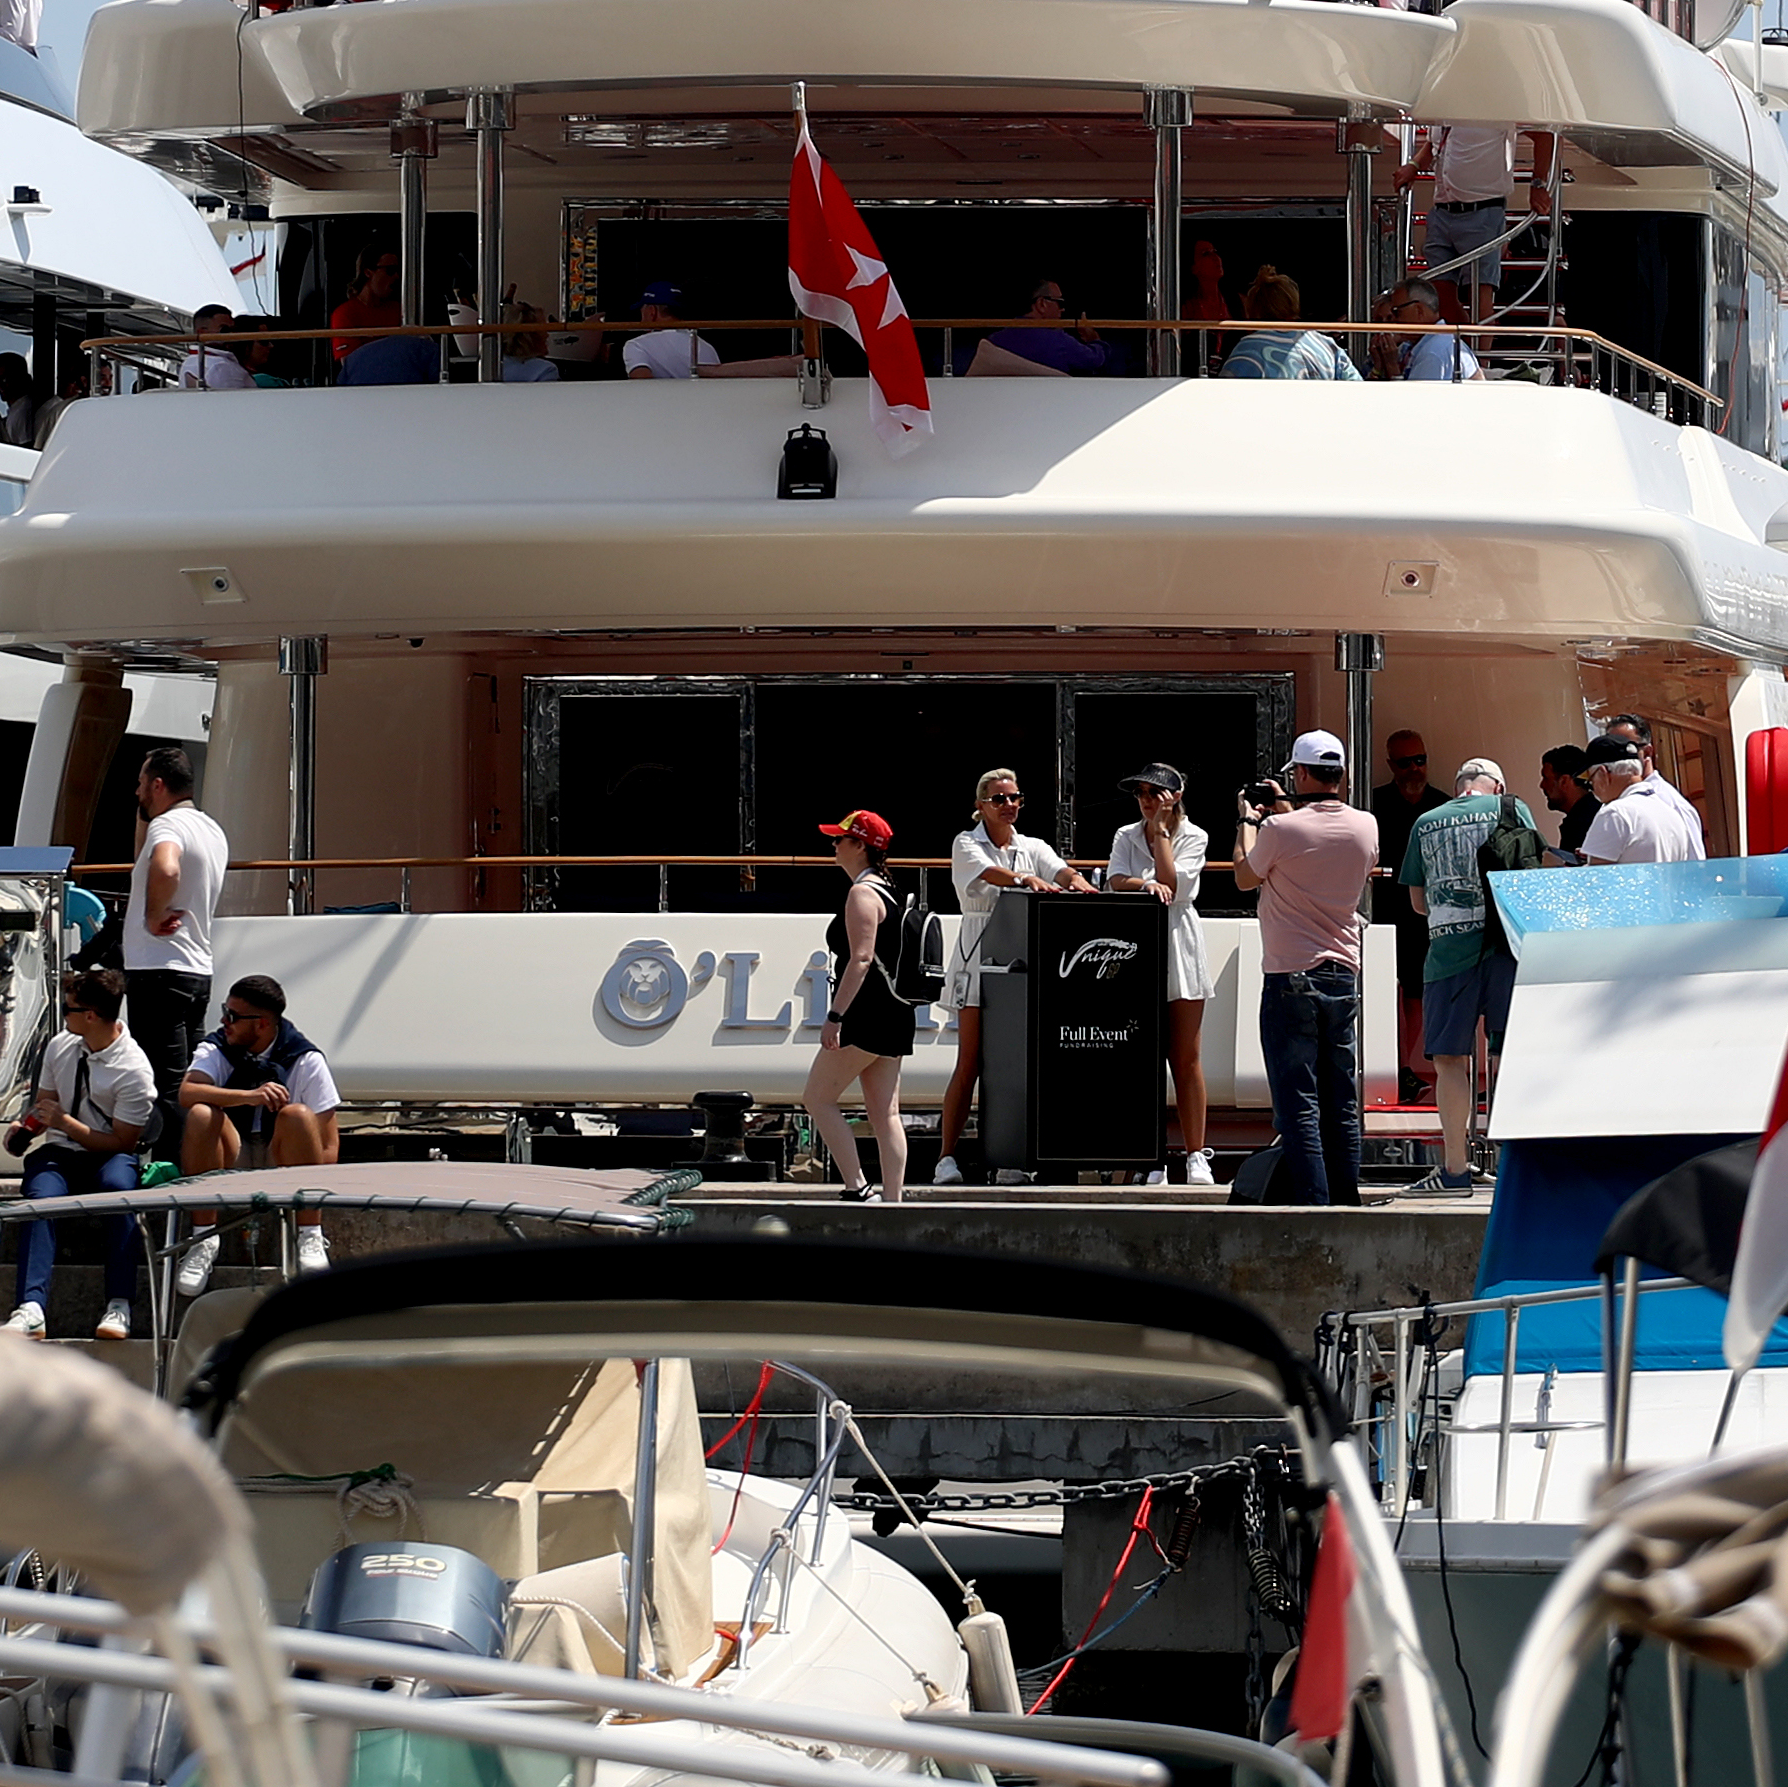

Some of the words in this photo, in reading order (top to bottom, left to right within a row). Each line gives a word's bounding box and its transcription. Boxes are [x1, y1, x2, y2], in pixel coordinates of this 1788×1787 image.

[1417, 817, 1447, 837] NOAH
[1451, 810, 1498, 826] KAHAN
[1428, 924, 1454, 940] STICK
[1456, 920, 1486, 933] SEAS
[1059, 938, 1138, 979] Unique
[600, 941, 959, 1030] O'Li
[1059, 1026, 1087, 1041] Full
[1090, 1026, 1129, 1042] Event
[360, 1553, 447, 1572] 250
